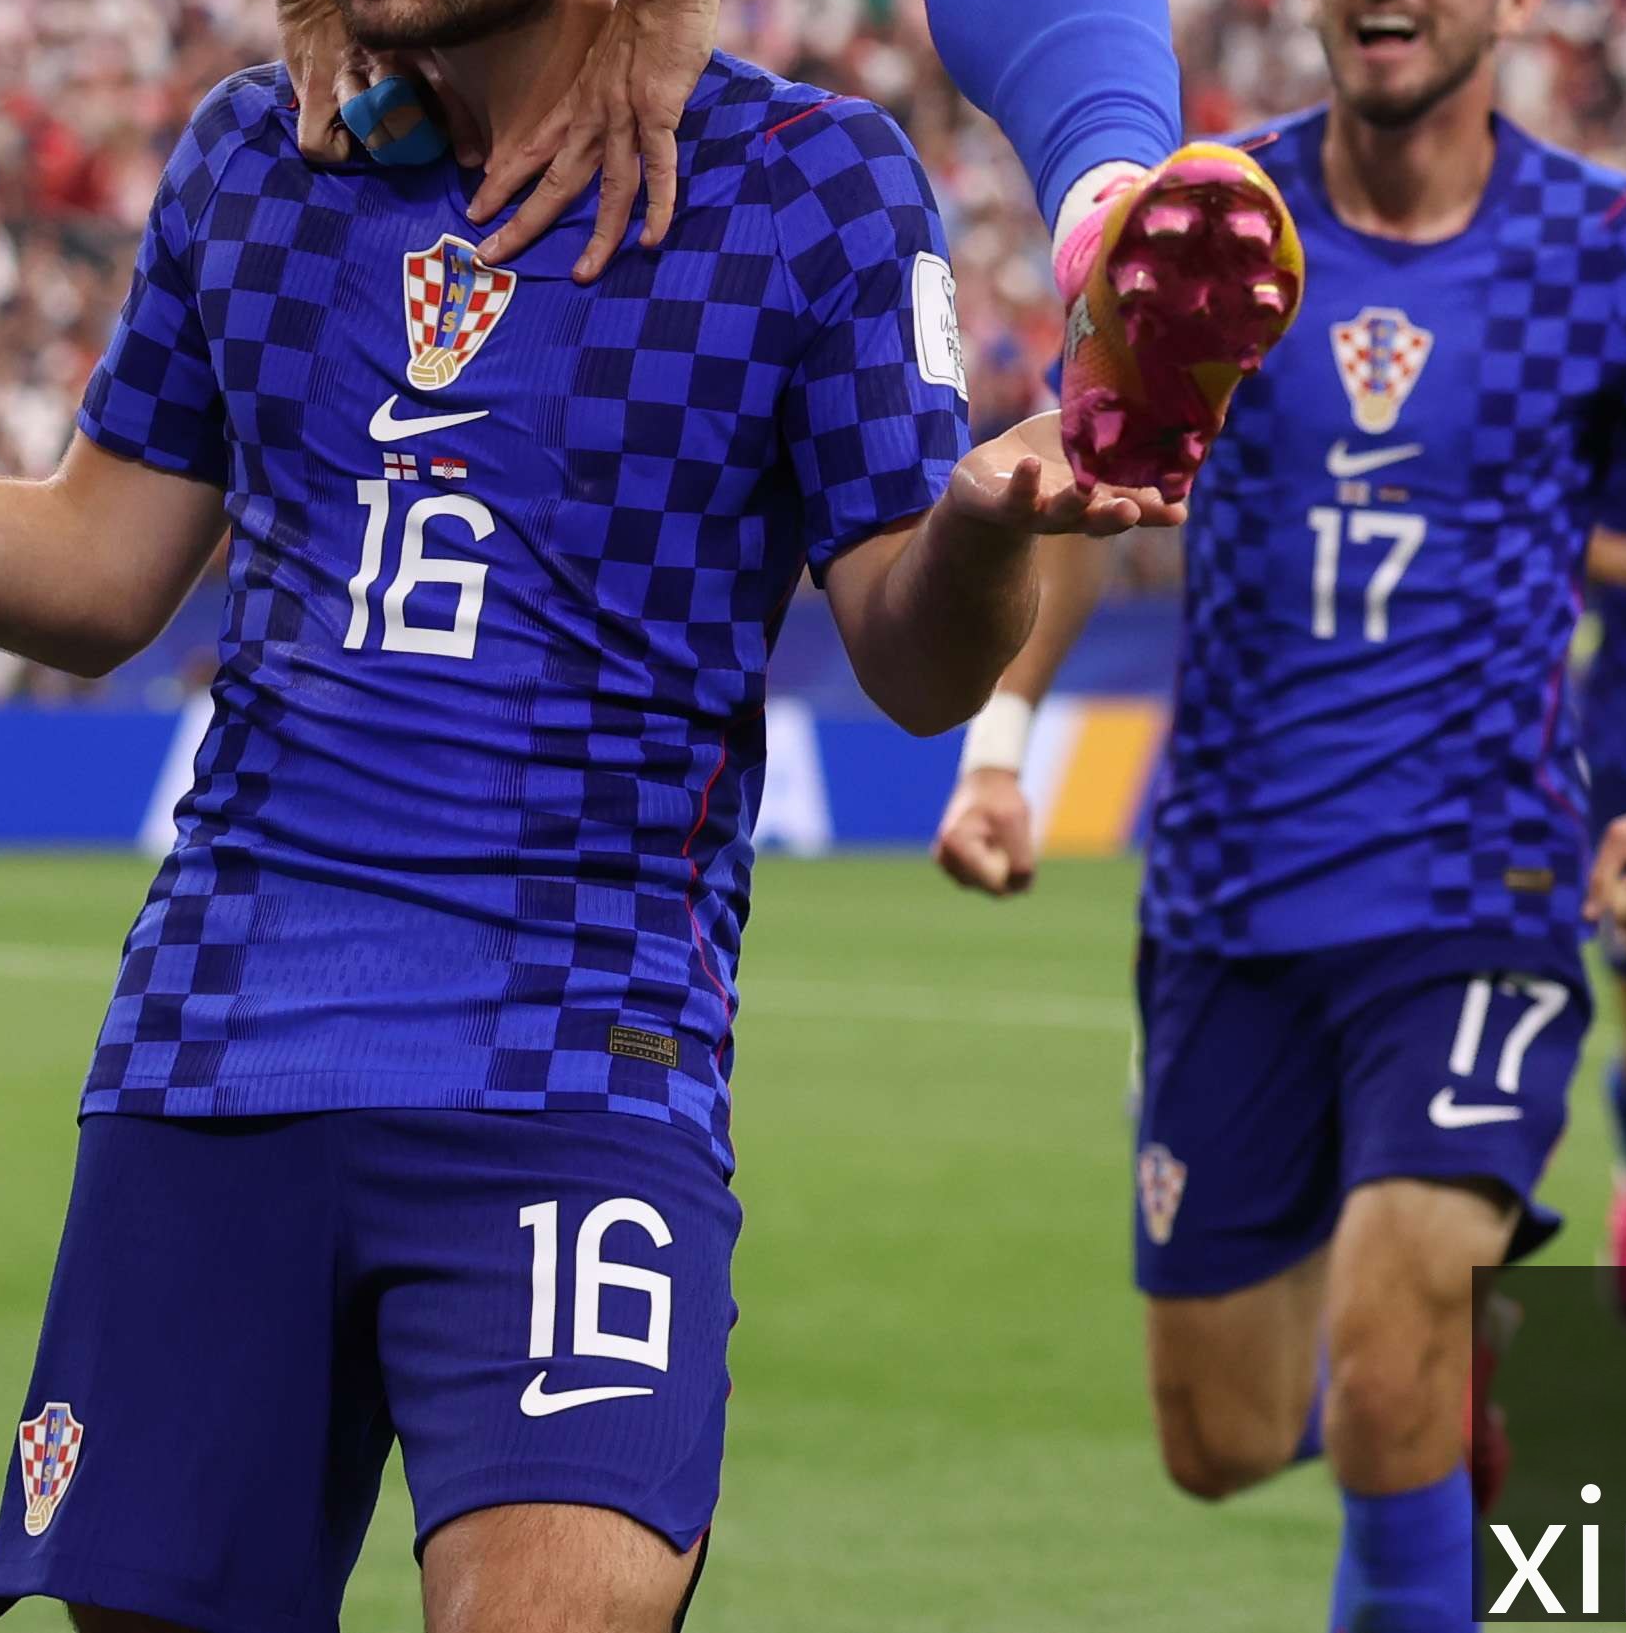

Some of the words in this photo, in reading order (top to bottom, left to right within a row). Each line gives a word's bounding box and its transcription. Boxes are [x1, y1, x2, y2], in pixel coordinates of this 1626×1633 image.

[441, 254, 468, 334] HNS
[342, 479, 496, 660] 16
[1307, 505, 1427, 642] 17
[1448, 976, 1570, 1095] 17
[519, 1197, 674, 1373] 16
